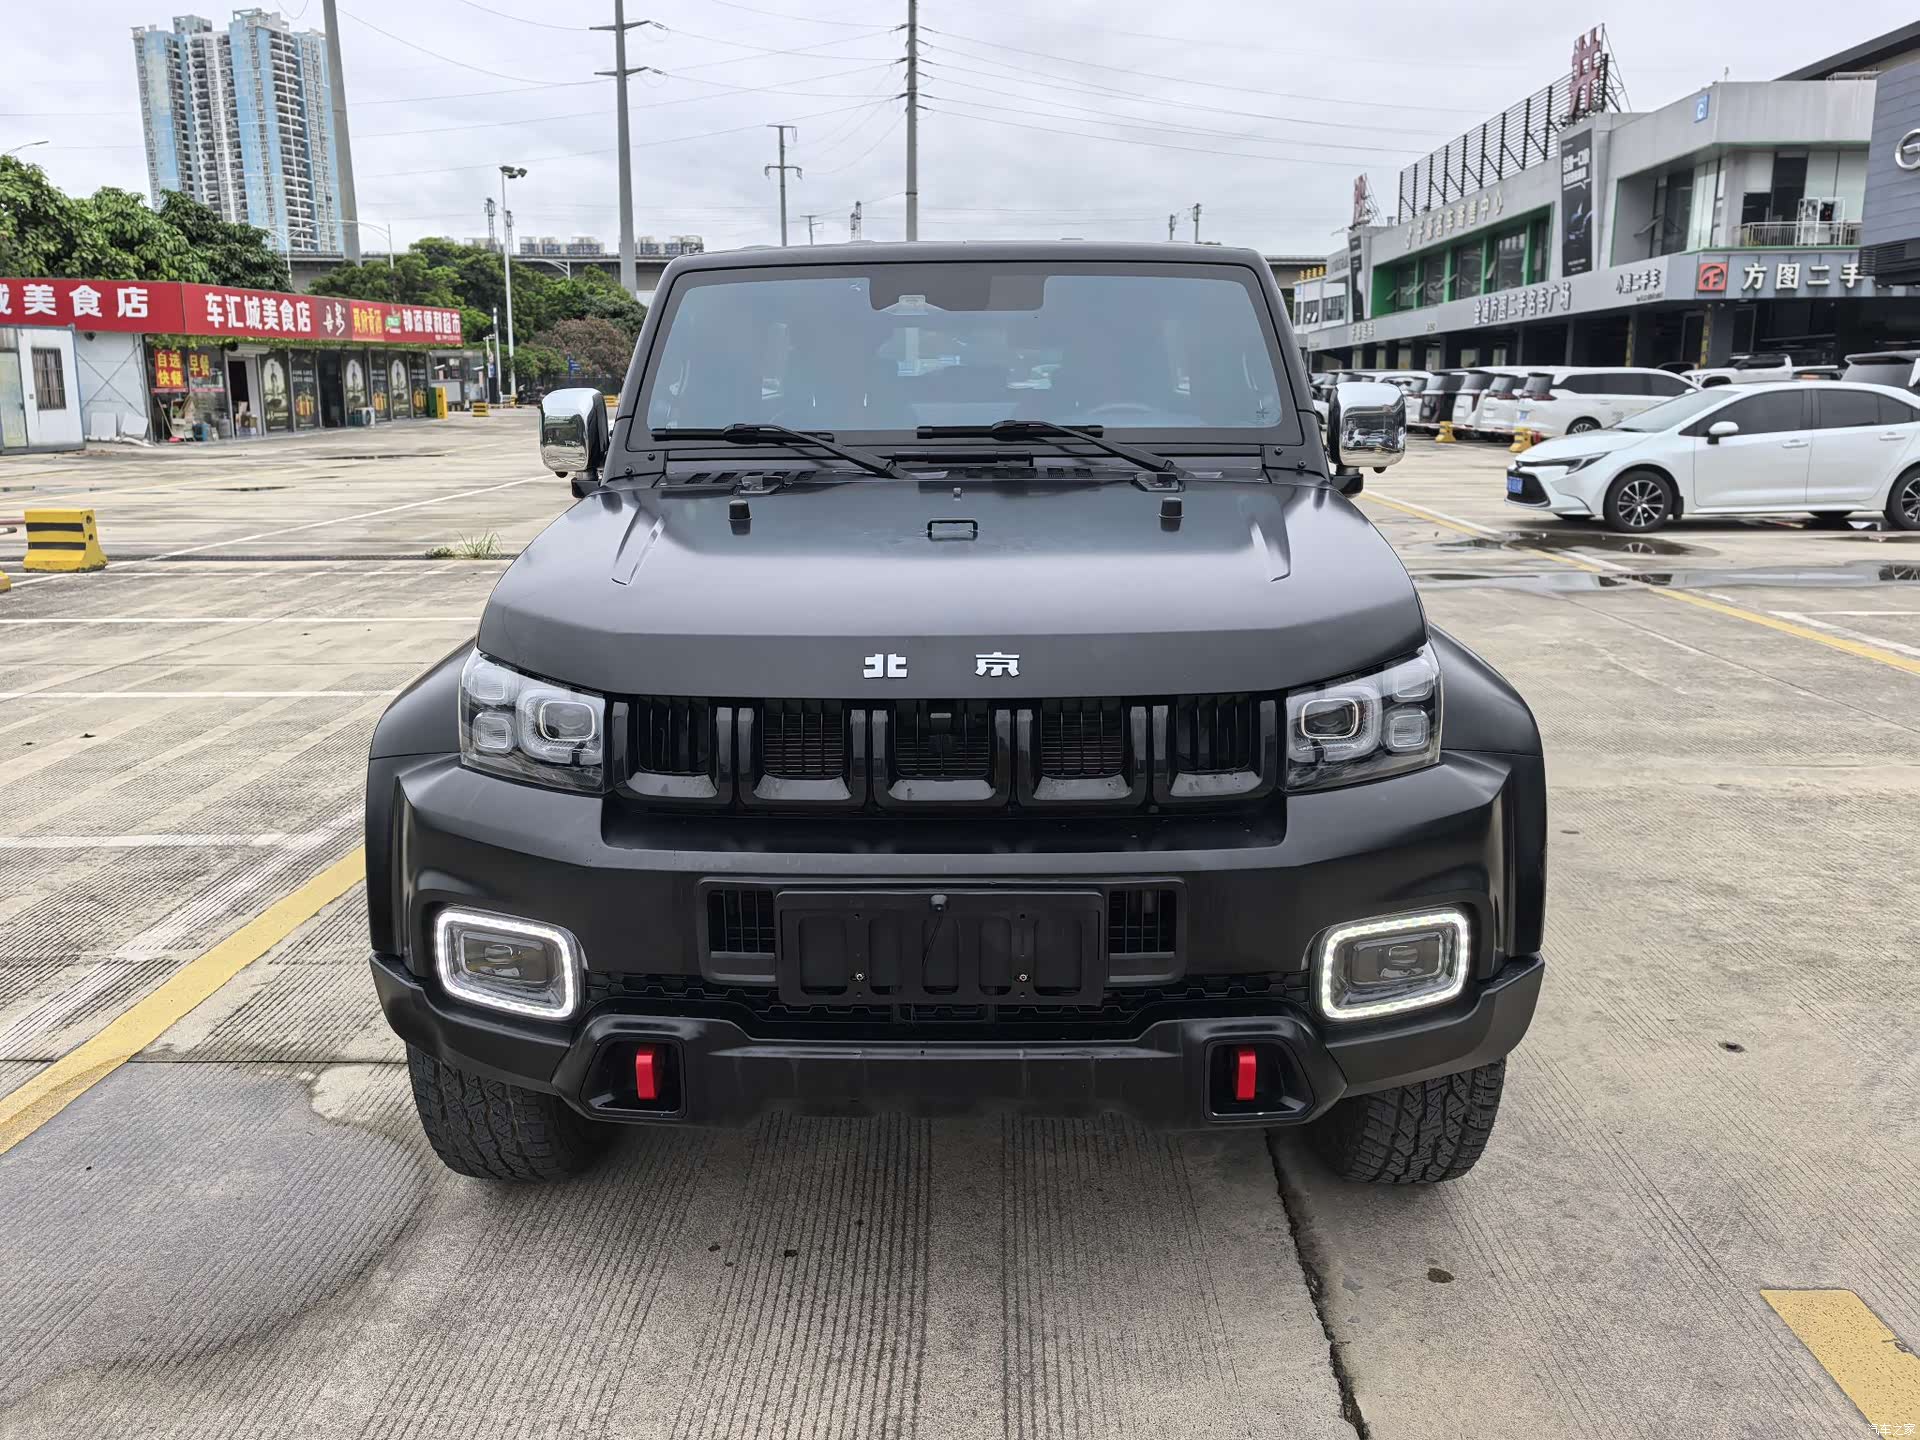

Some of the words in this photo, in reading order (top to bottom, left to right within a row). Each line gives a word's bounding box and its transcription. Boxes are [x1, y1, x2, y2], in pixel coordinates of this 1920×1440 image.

[1741, 263, 1864, 290] 方图二手
[205, 292, 311, 332] 车汇城美食店
[157, 369, 182, 386] 快餐
[189, 354, 209, 376] 早餐
[863, 651, 1020, 679] 北京
